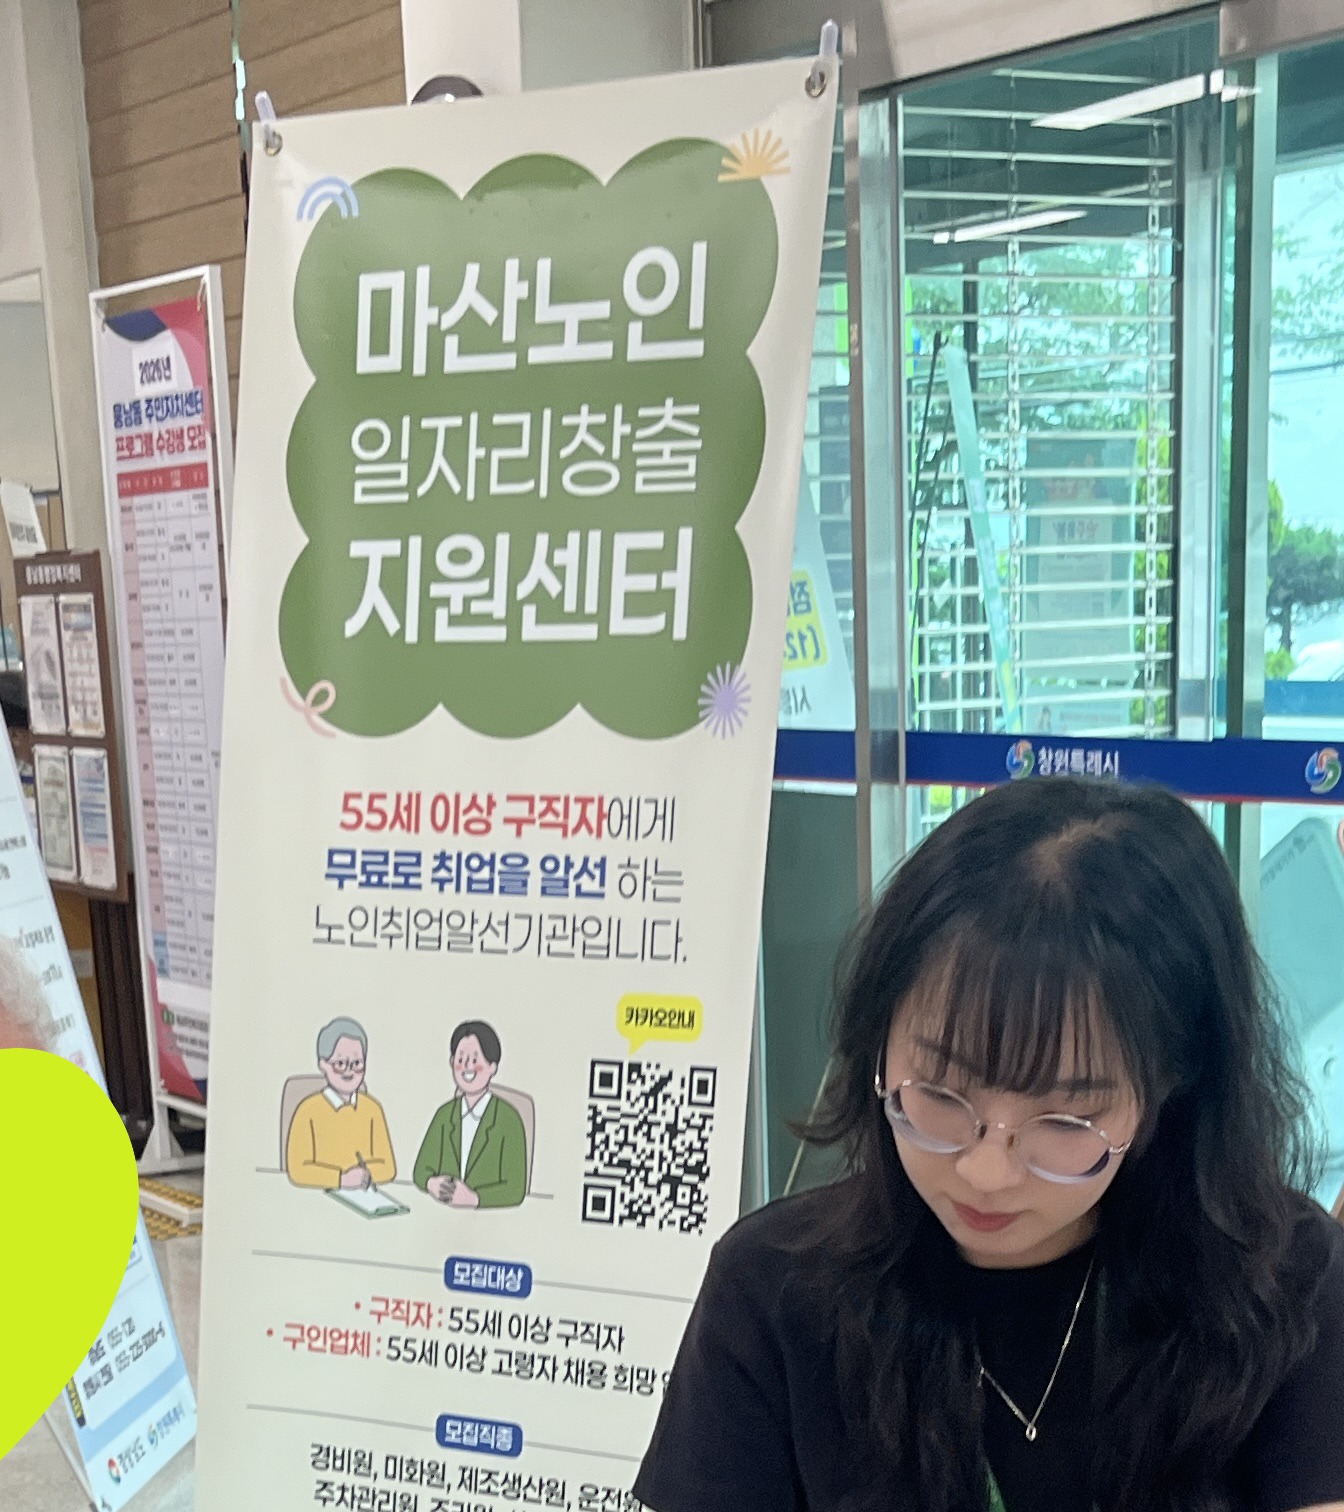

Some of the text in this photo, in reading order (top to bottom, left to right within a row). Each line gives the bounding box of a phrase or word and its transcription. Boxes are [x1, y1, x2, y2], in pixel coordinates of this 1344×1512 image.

[355, 241, 708, 376] 마산노인
[116, 424, 207, 460] 프로그램 수강생 모집
[350, 397, 702, 505] 일자리창출
[343, 525, 694, 644] 지원센터
[1036, 749, 1120, 779] 창원특례시
[339, 790, 677, 844] 55세 이상 구직자에게
[324, 848, 684, 903] 무료로 취업을 알선 하는
[311, 904, 689, 965] 노인취업알선기관입니다.
[624, 1005, 696, 1032] 카카오안내
[452, 1261, 524, 1294] 모집대상
[448, 1305, 503, 1336] 55세
[508, 1314, 551, 1345] 이상
[556, 1318, 625, 1355] 구직자
[386, 1335, 439, 1369] 55세
[443, 1342, 487, 1375] 이상
[491, 1347, 558, 1385] 고령자
[561, 1357, 608, 1391] 채용
[612, 1362, 656, 1398] 희망
[444, 1418, 514, 1453] 모집직종
[310, 1442, 379, 1483] 경비원,
[383, 1454, 452, 1494] 미화원,
[457, 1465, 572, 1512] 제조생산원,
